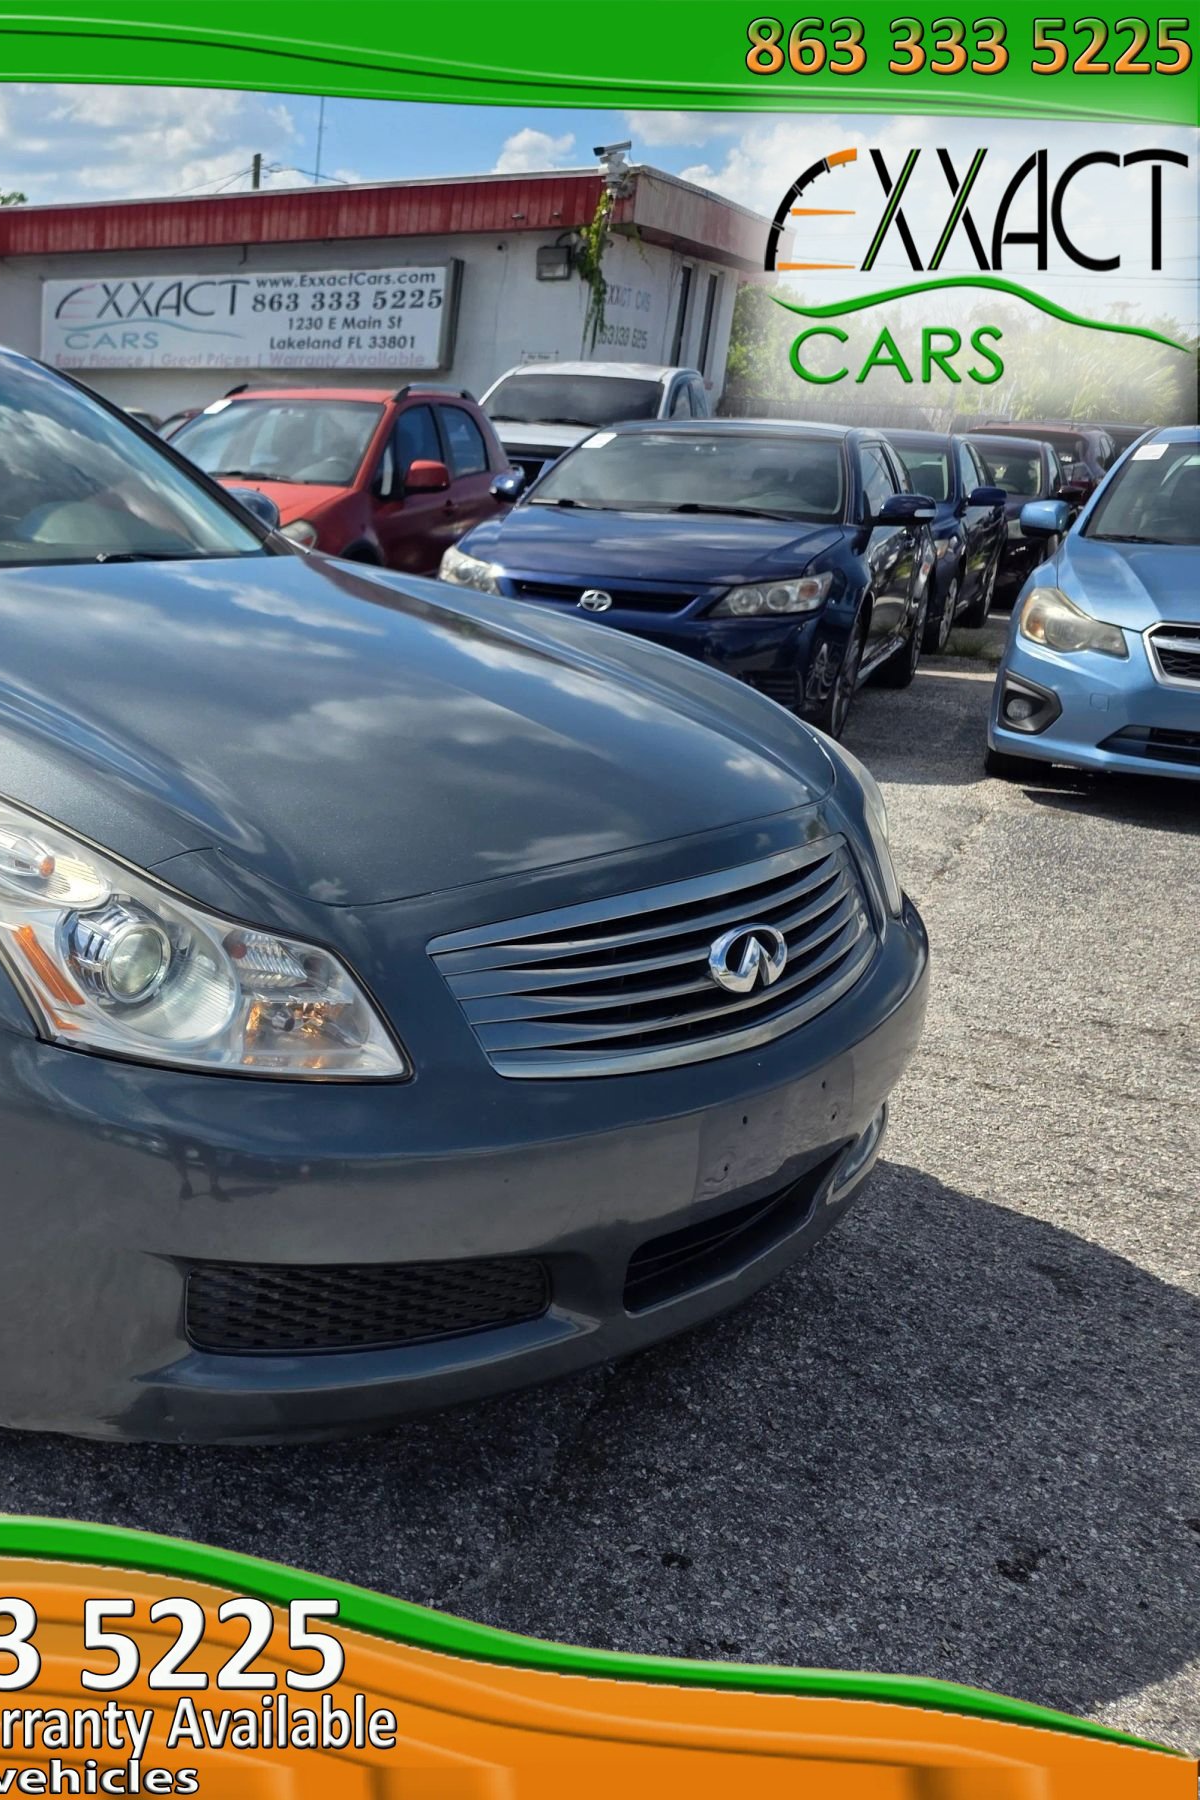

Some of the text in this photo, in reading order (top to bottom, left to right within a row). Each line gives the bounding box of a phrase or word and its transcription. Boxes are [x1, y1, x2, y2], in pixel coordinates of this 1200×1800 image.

[255, 271, 437, 289] www.ExxactCars.com
[54, 279, 251, 319] EXXACT
[251, 288, 443, 313] 863 333 5225
[288, 315, 403, 331] 1230 E Main St
[64, 331, 160, 350] CARS
[269, 336, 416, 350] Lakeland FL 33801
[269, 352, 340, 368] Warranty
[344, 351, 426, 367] Available
